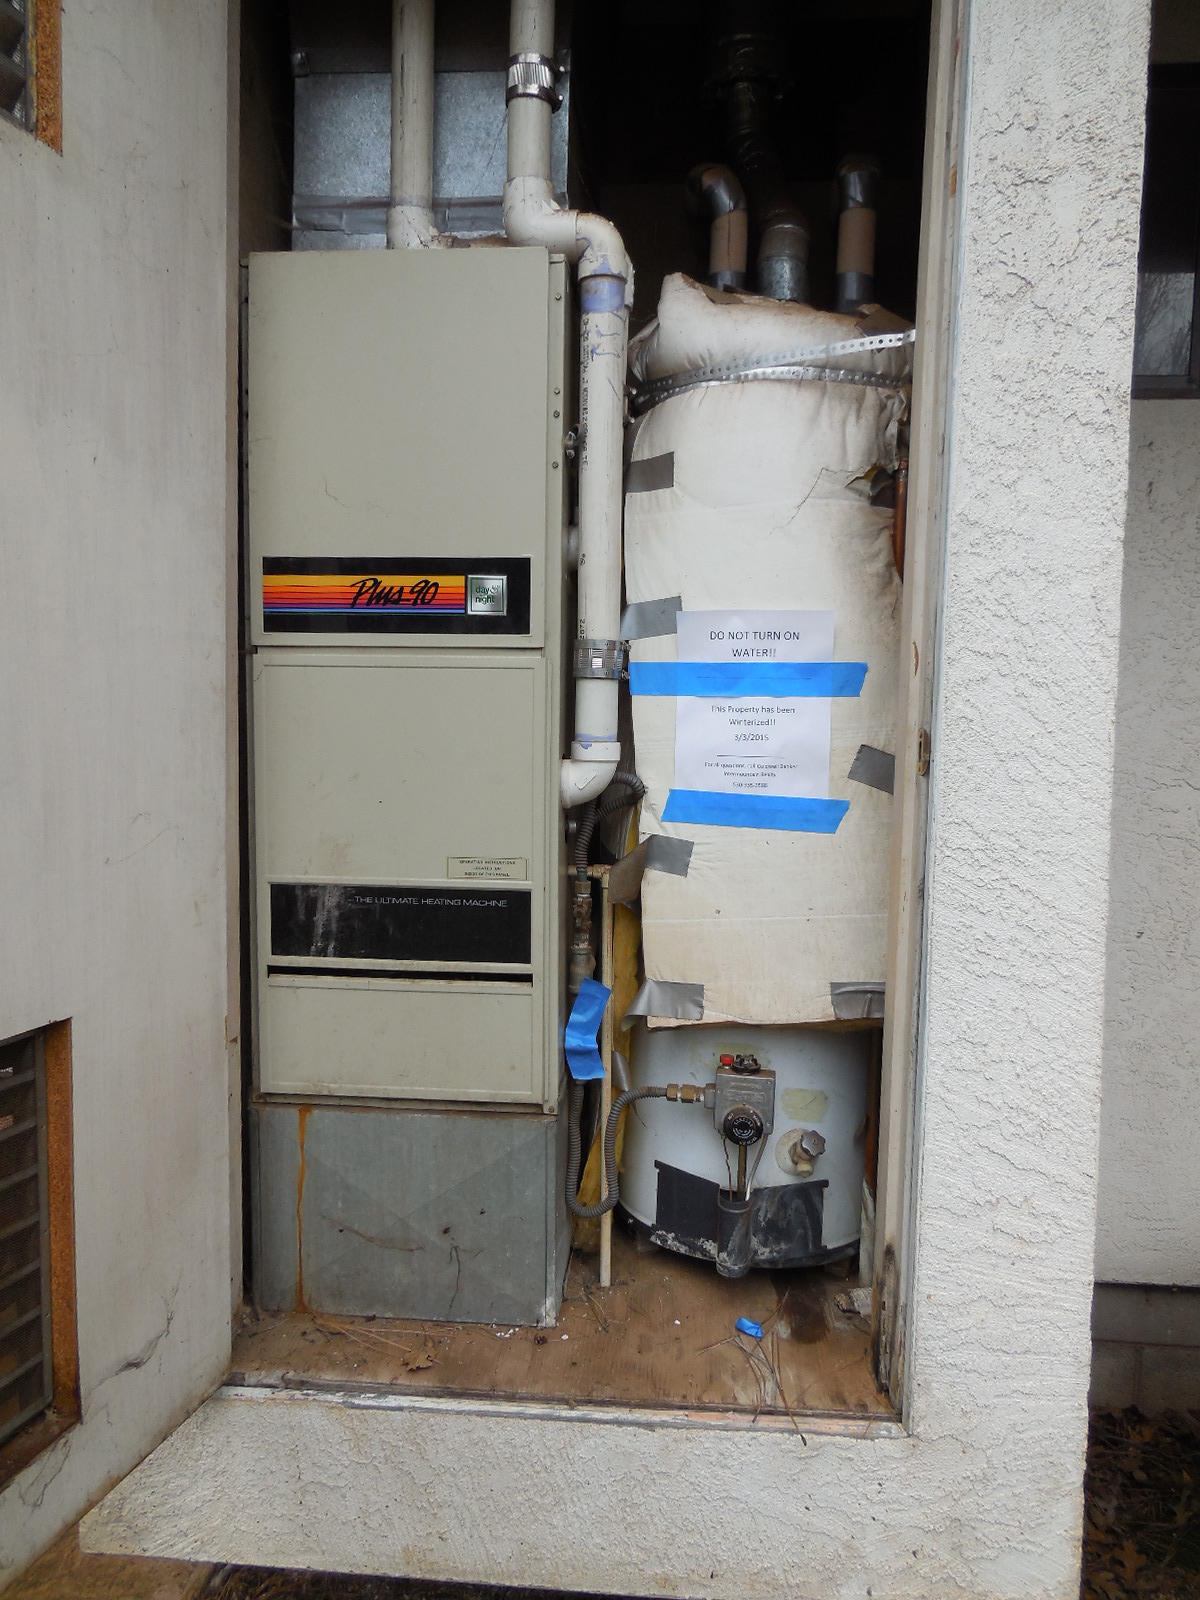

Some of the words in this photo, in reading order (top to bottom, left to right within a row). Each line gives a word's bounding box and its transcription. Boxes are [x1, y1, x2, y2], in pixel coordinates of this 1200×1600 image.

[351, 577, 410, 608] Plus
[410, 578, 440, 606] 90
[475, 594, 496, 605] night
[709, 630, 725, 641] DO
[728, 631, 749, 641] NOT
[752, 631, 781, 641] TURN
[783, 630, 800, 641] ON
[732, 648, 777, 658] WATER!!
[711, 704, 726, 713] This
[727, 705, 759, 715] Property
[761, 705, 775, 714] has
[776, 706, 796, 714] been
[354, 896, 373, 904] THE
[375, 896, 419, 905] ULTIMATE
[421, 898, 461, 906] HEATING
[463, 899, 508, 908] MACHINE
